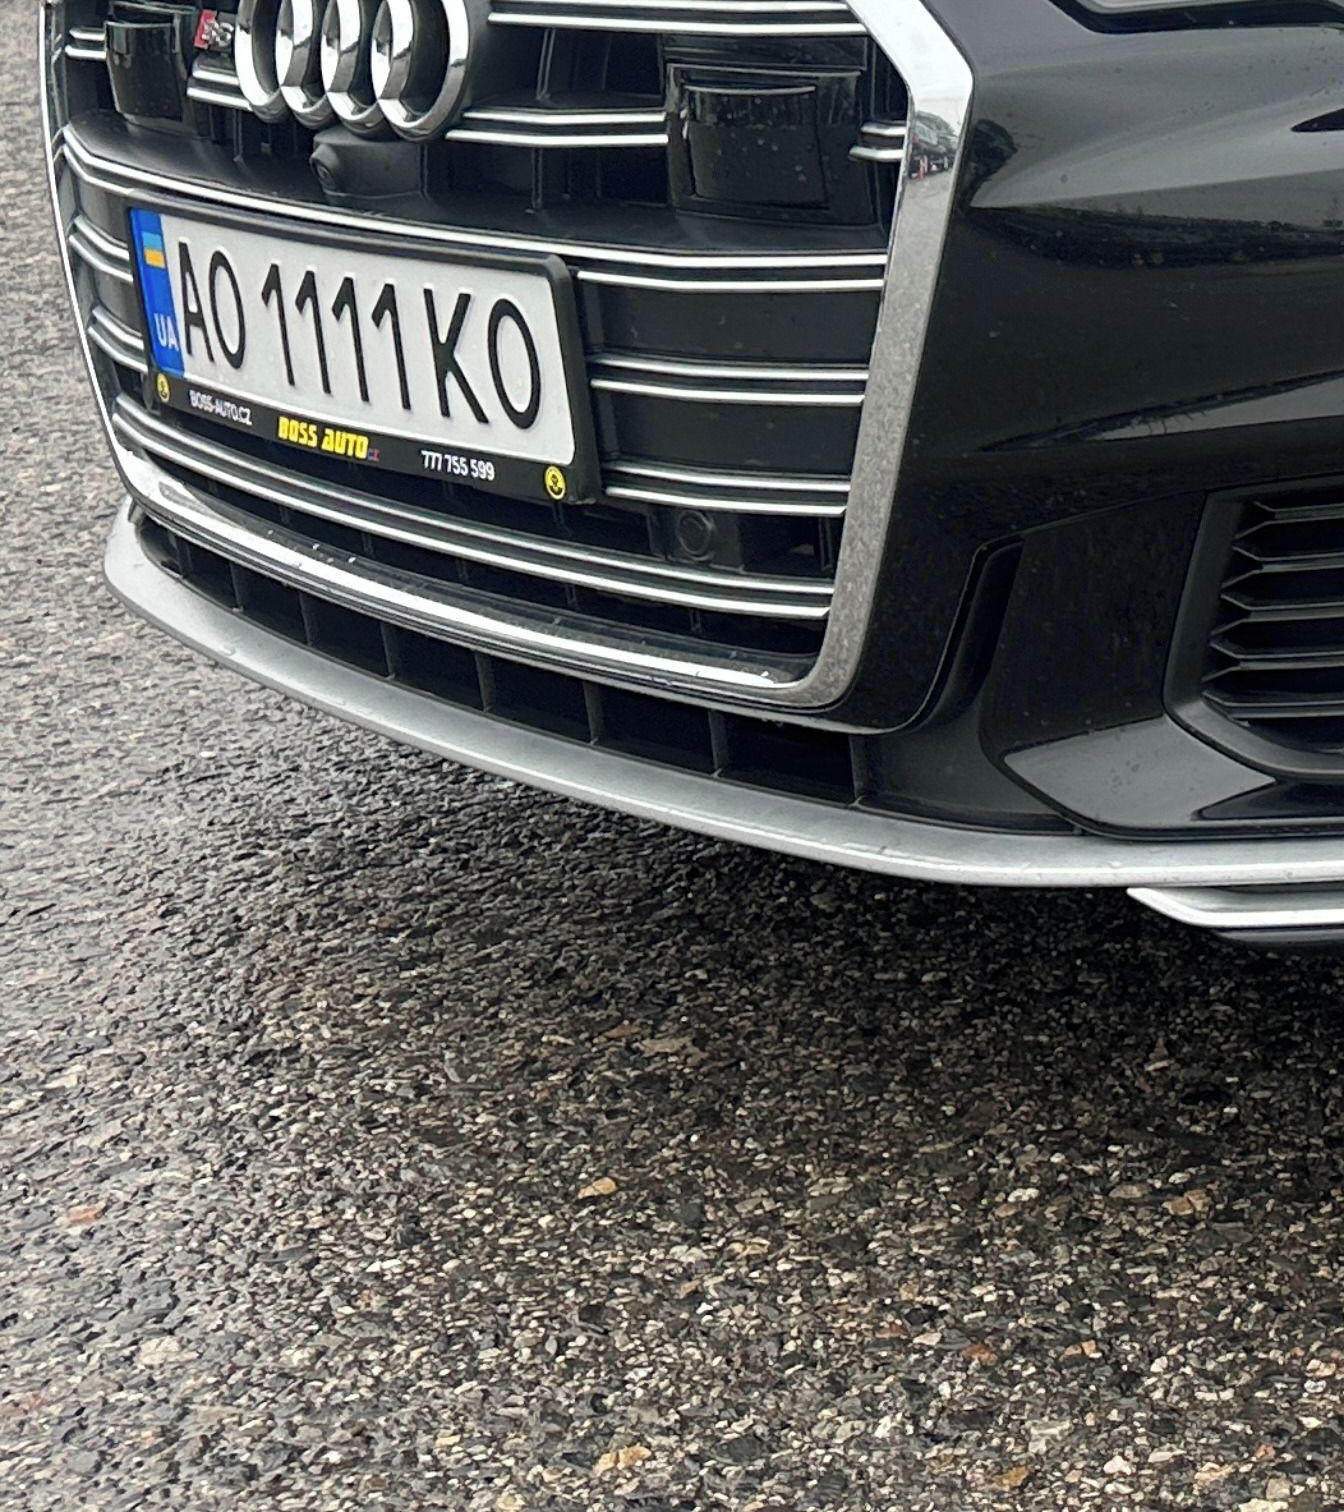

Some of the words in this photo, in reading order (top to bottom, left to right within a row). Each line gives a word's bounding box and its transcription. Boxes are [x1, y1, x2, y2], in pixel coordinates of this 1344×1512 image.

[153, 313, 180, 351] UA
[178, 241, 246, 369] AO
[261, 263, 411, 410] 1111
[423, 288, 542, 430] KO
[189, 390, 253, 426] BOSS-AUTO.CZ
[278, 416, 317, 448] BOSS
[321, 427, 369, 459] AUTO
[420, 450, 443, 471] 777
[444, 454, 469, 476] 755
[470, 459, 496, 481] 599
